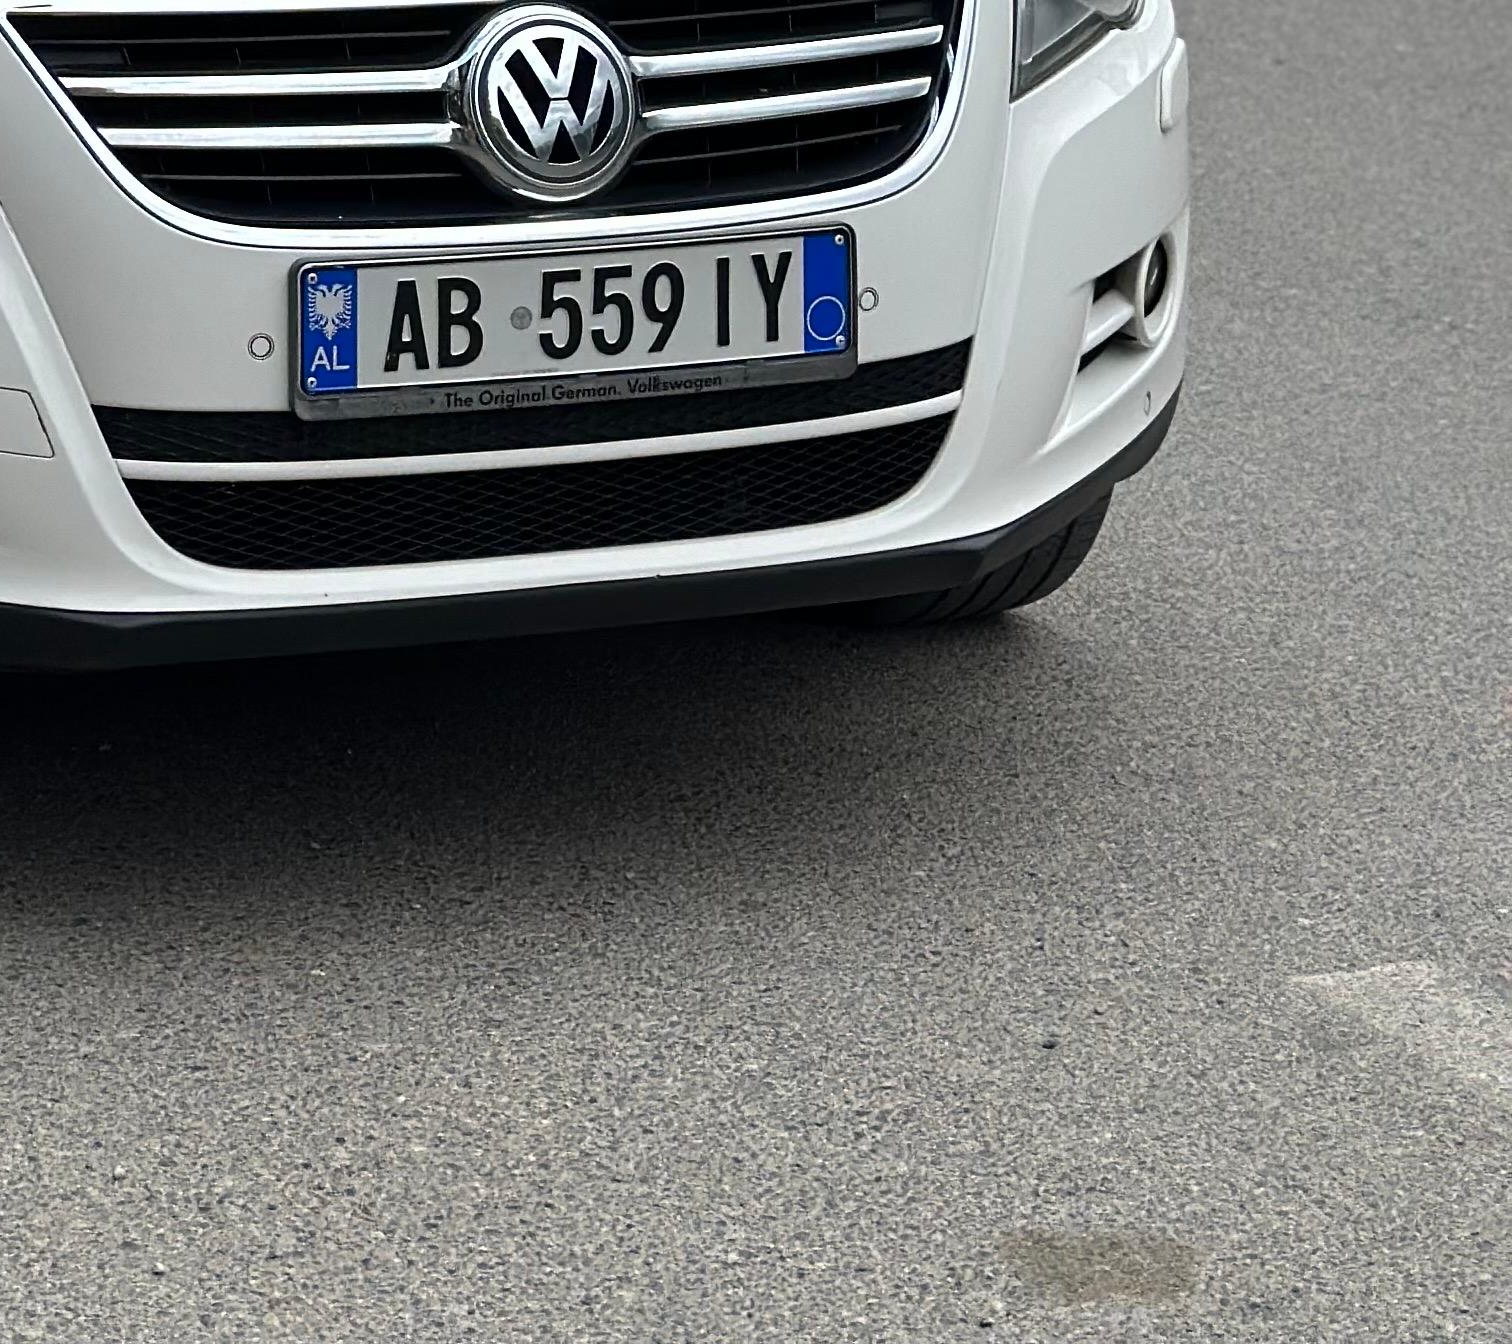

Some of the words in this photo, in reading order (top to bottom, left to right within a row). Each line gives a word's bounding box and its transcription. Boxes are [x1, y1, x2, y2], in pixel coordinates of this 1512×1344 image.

[491, 27, 620, 172] VW
[384, 276, 484, 372] AB
[538, 261, 686, 361] 559
[715, 250, 793, 347] IY
[311, 344, 351, 372] AL
[444, 391, 474, 409] The
[479, 383, 547, 408] Original
[627, 374, 722, 395] Volkswagen
